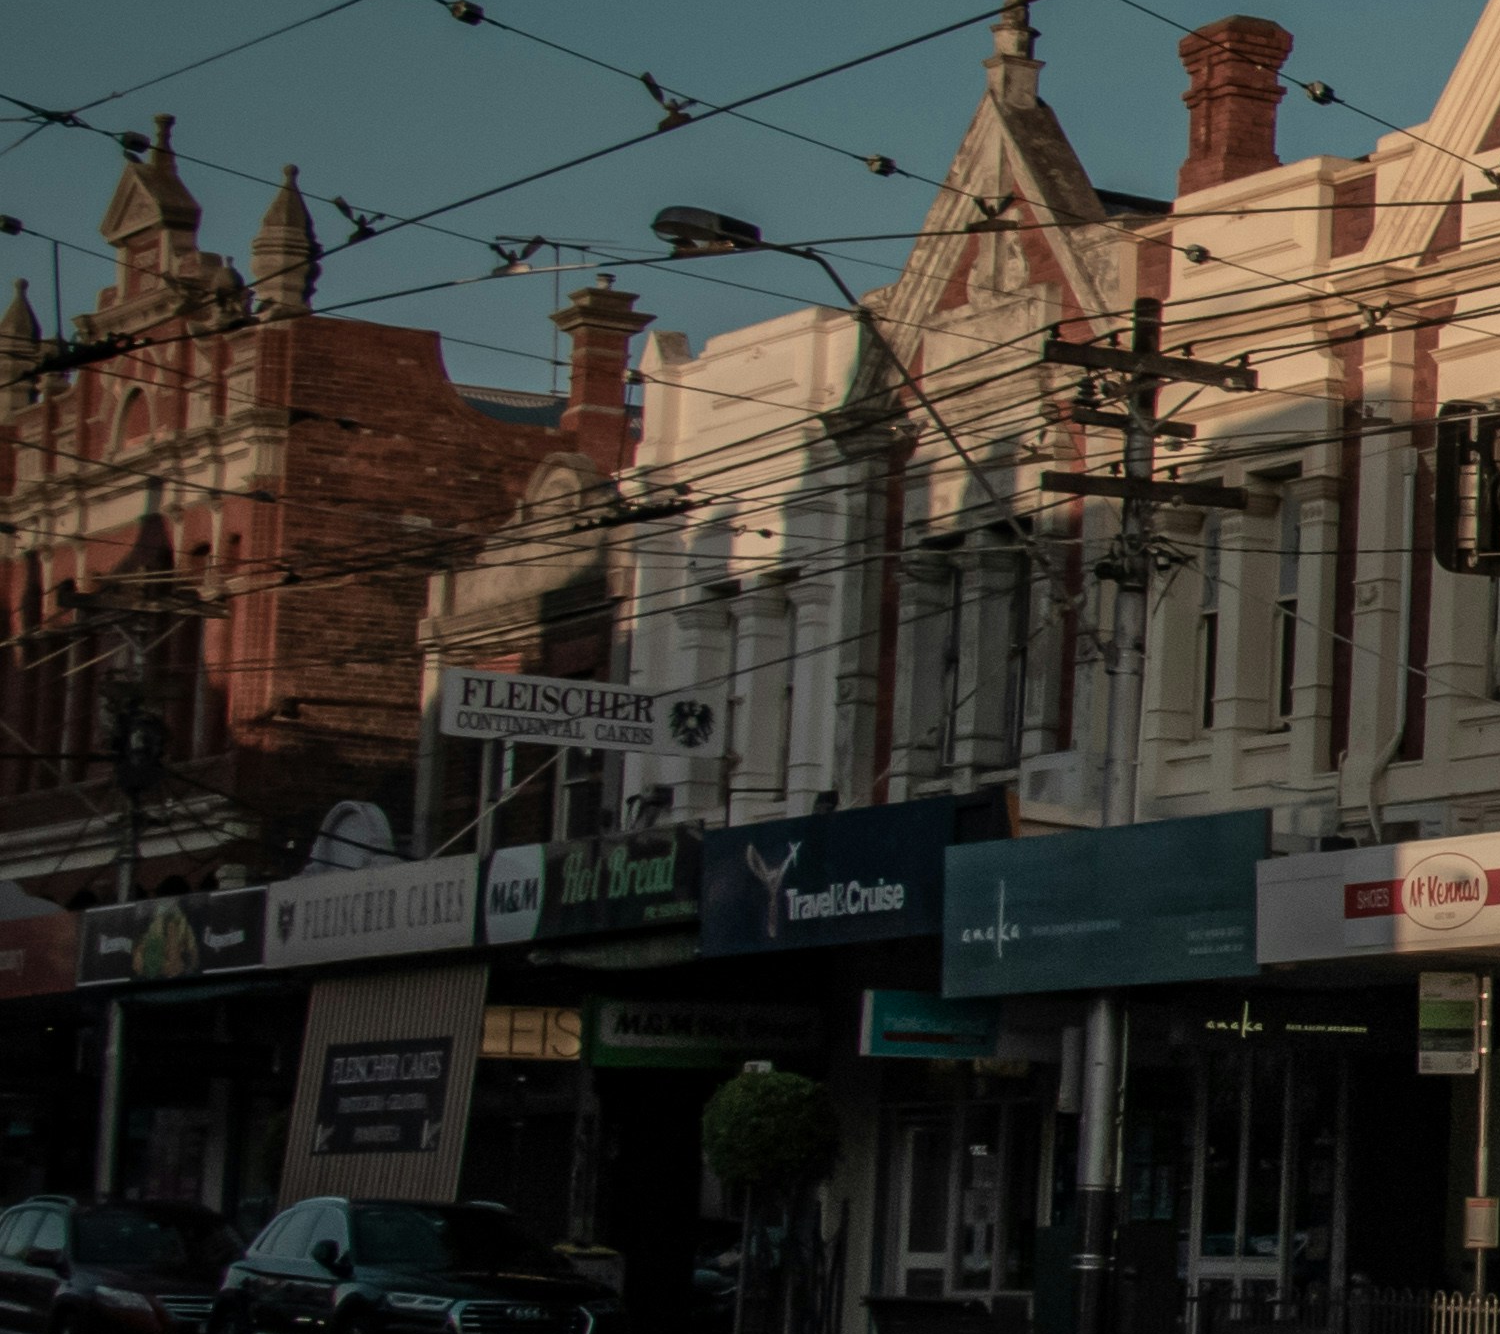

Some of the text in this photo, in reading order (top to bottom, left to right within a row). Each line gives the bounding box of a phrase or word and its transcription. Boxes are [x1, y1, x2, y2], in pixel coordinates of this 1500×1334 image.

[461, 676, 655, 724] FLEISCHER
[456, 710, 655, 745] CONTINENTAL CAKES
[1356, 887, 1390, 910] SHOES
